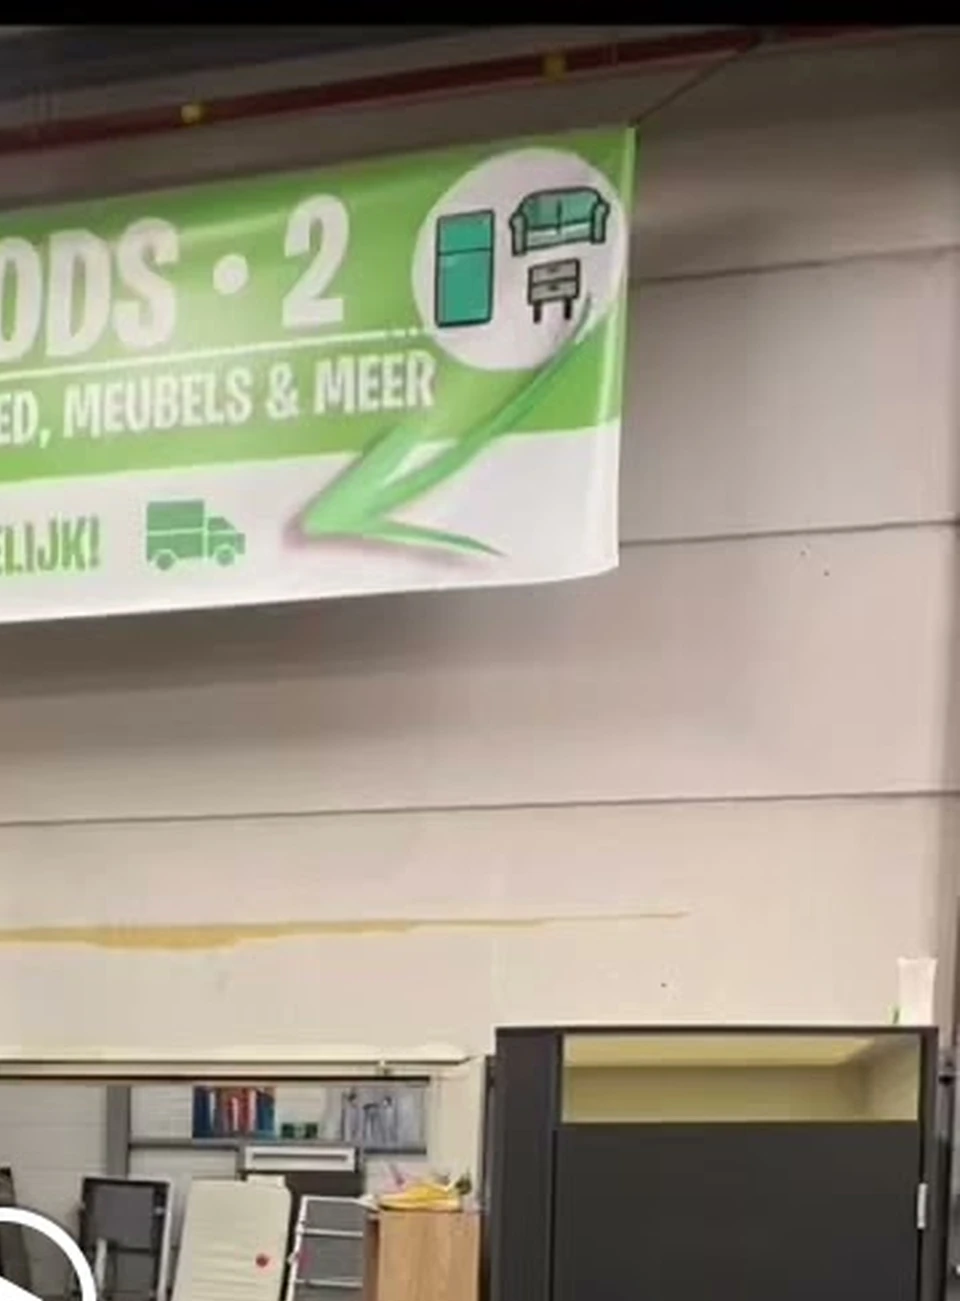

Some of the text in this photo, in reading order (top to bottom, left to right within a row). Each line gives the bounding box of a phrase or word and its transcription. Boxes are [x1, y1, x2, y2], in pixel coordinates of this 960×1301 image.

[281, 194, 350, 329] 2
[63, 367, 253, 437] MEUBELS
[267, 362, 300, 420] &
